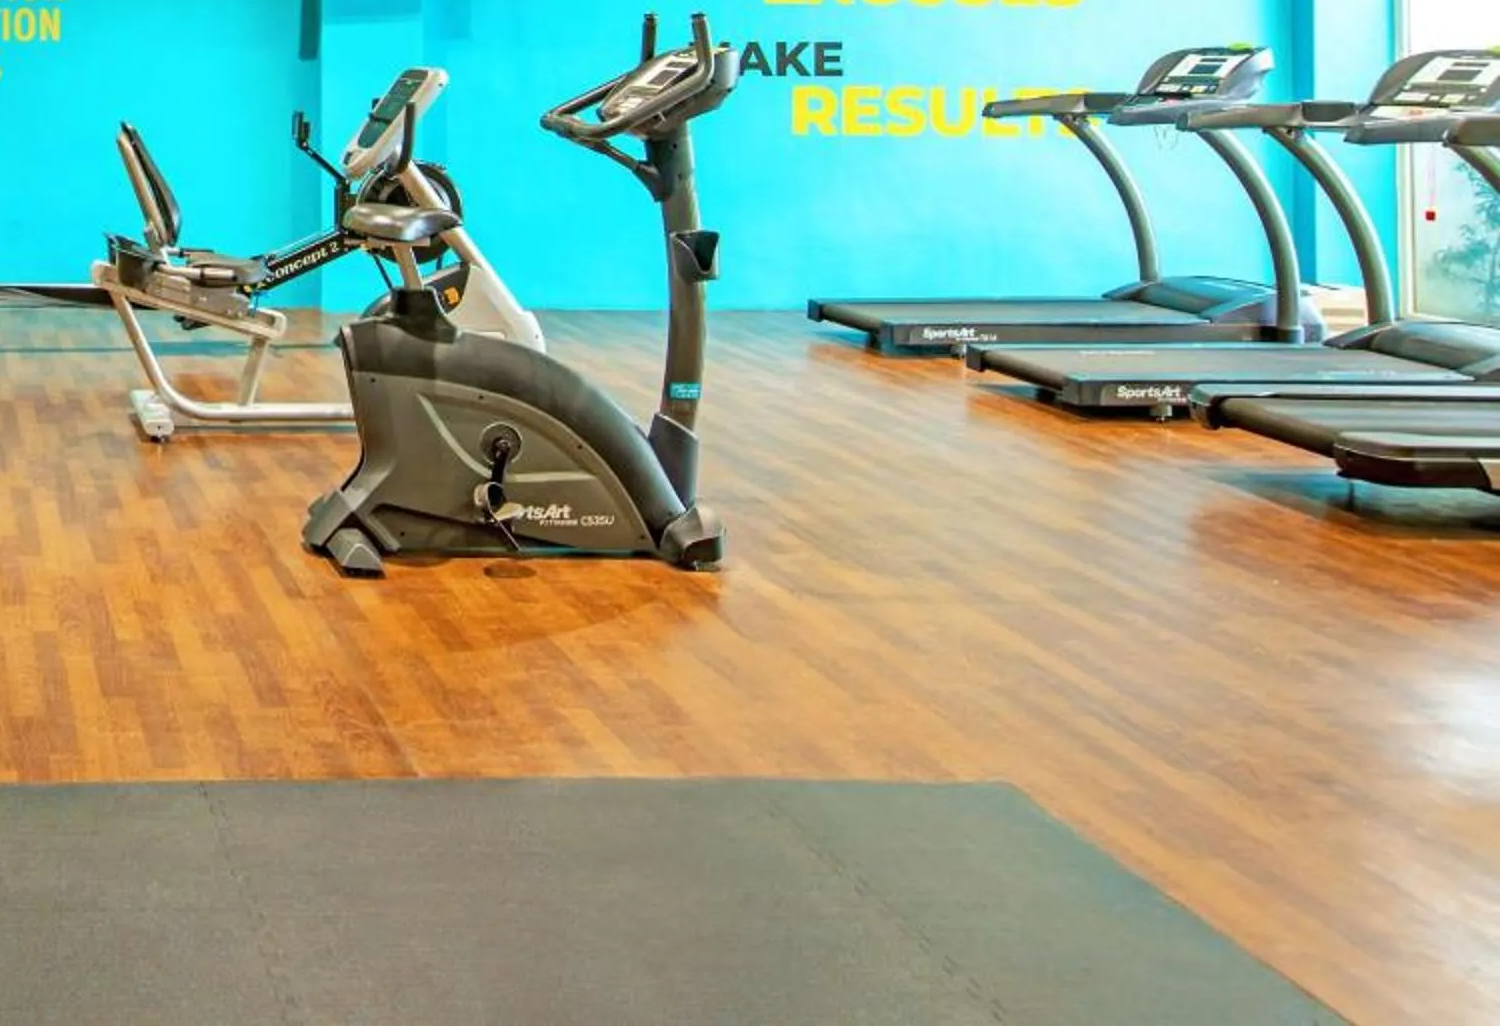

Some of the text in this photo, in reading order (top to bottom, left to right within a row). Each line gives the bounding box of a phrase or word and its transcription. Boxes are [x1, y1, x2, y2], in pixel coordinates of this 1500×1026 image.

[689, 41, 843, 77] AKE
[791, 85, 1100, 138] RESULT
[1116, 385, 1182, 399] SportsArt
